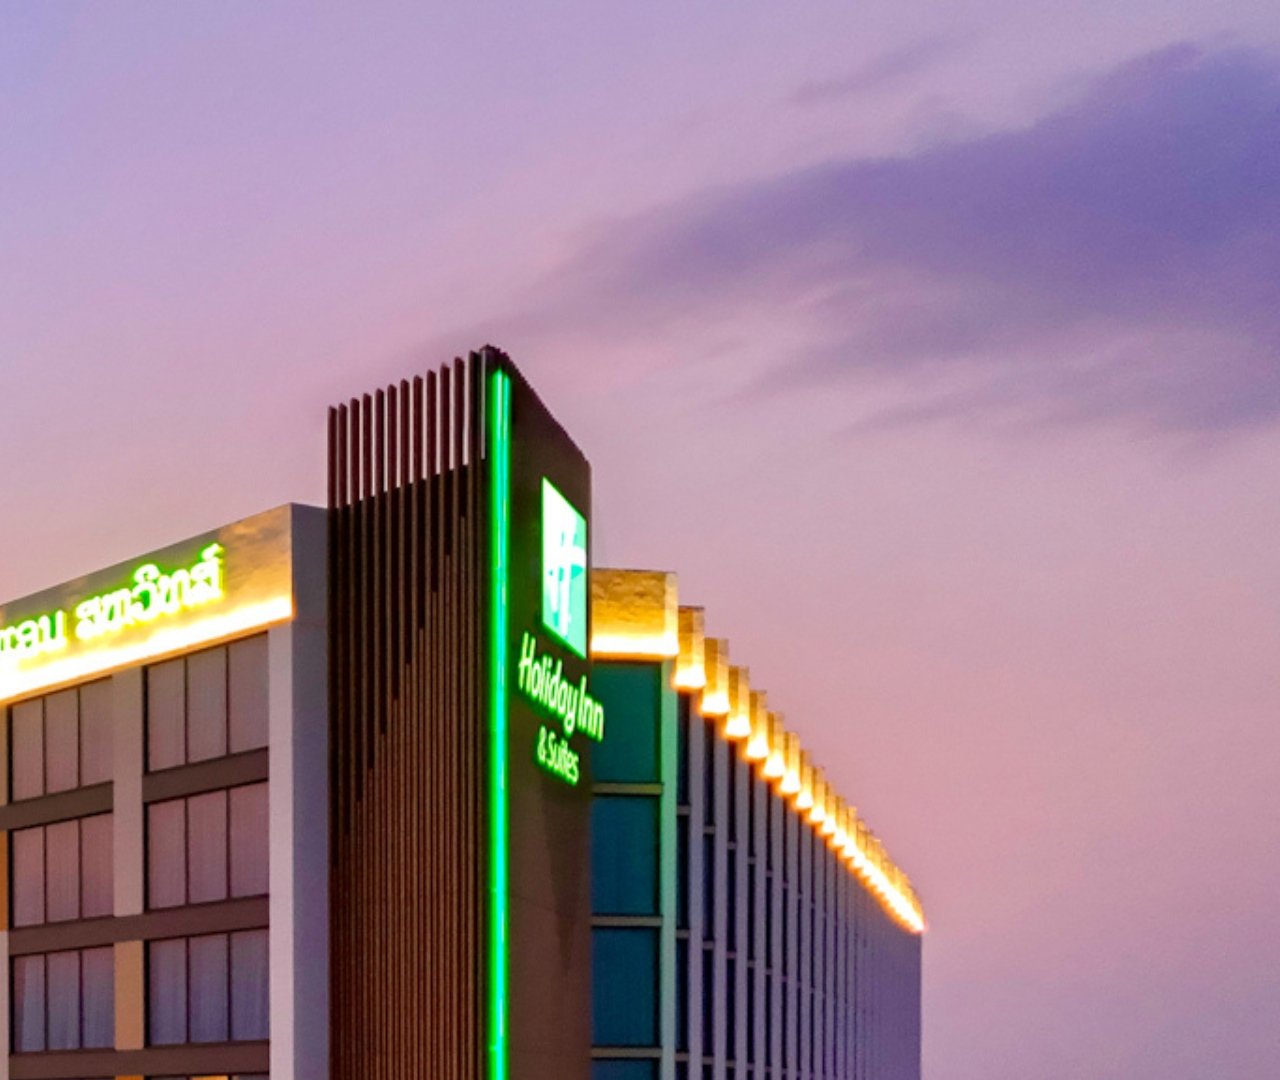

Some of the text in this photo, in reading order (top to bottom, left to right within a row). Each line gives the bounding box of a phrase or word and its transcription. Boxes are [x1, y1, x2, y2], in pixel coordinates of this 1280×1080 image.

[518, 631, 604, 742] Holiday Inn
[547, 733, 580, 786] Suites
